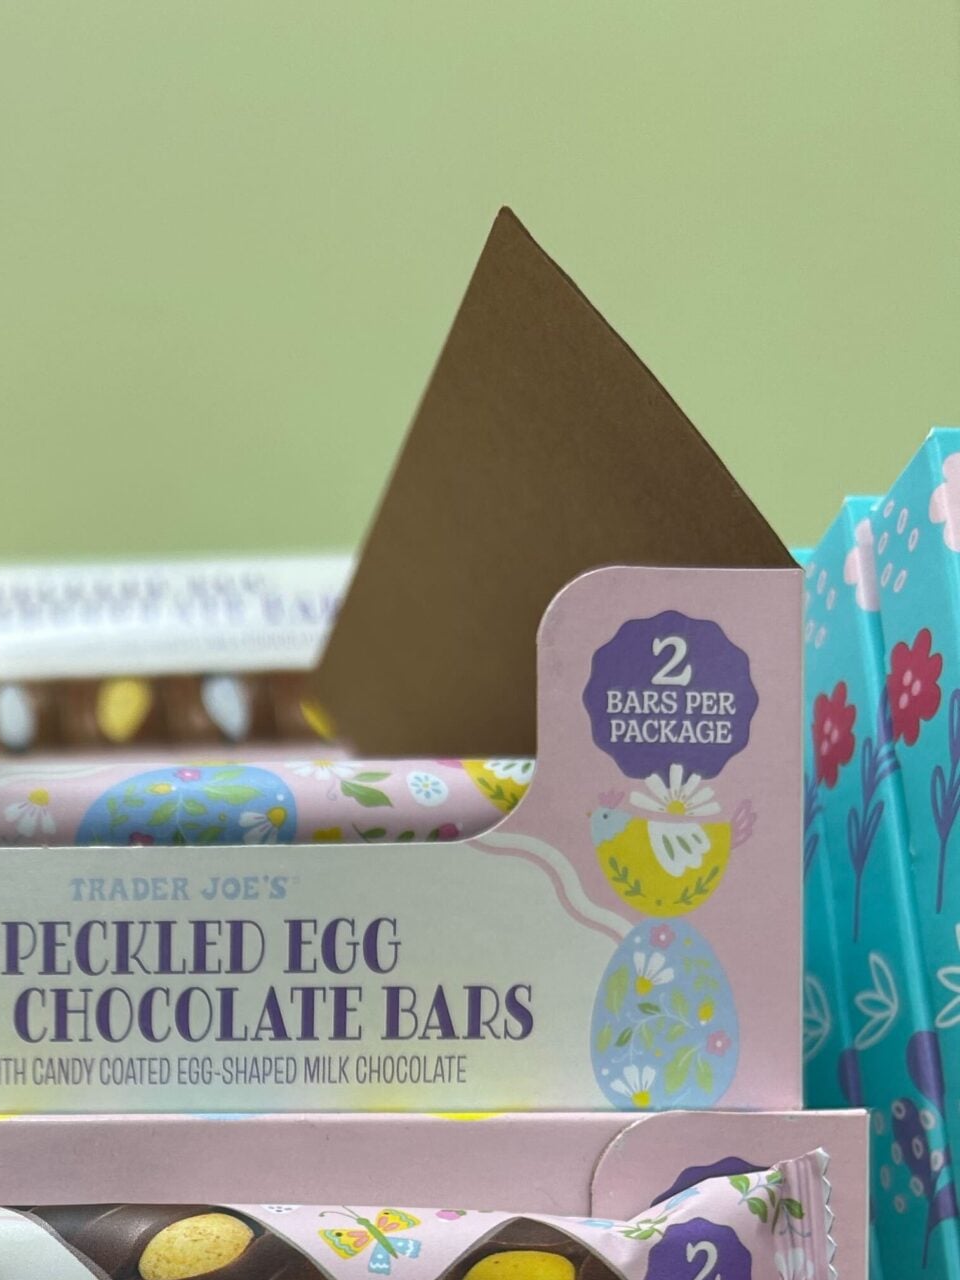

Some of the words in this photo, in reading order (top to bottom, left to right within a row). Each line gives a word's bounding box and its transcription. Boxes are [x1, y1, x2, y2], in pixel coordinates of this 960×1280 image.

[651, 636, 692, 686] 2
[606, 690, 677, 714] BARS
[685, 691, 736, 715] PER
[609, 719, 732, 744] PACKAGE
[70, 877, 190, 901] TRADER
[284, 917, 402, 974] EGG
[13, 986, 363, 1043] CHOCOLATE
[380, 984, 535, 1041] BARS
[32, 1057, 94, 1086] CANDY
[99, 1056, 171, 1085] COATED
[176, 1055, 298, 1085] EGG-SHAPED
[303, 1055, 351, 1084] MILK
[355, 1055, 468, 1084] CHOCOLATE
